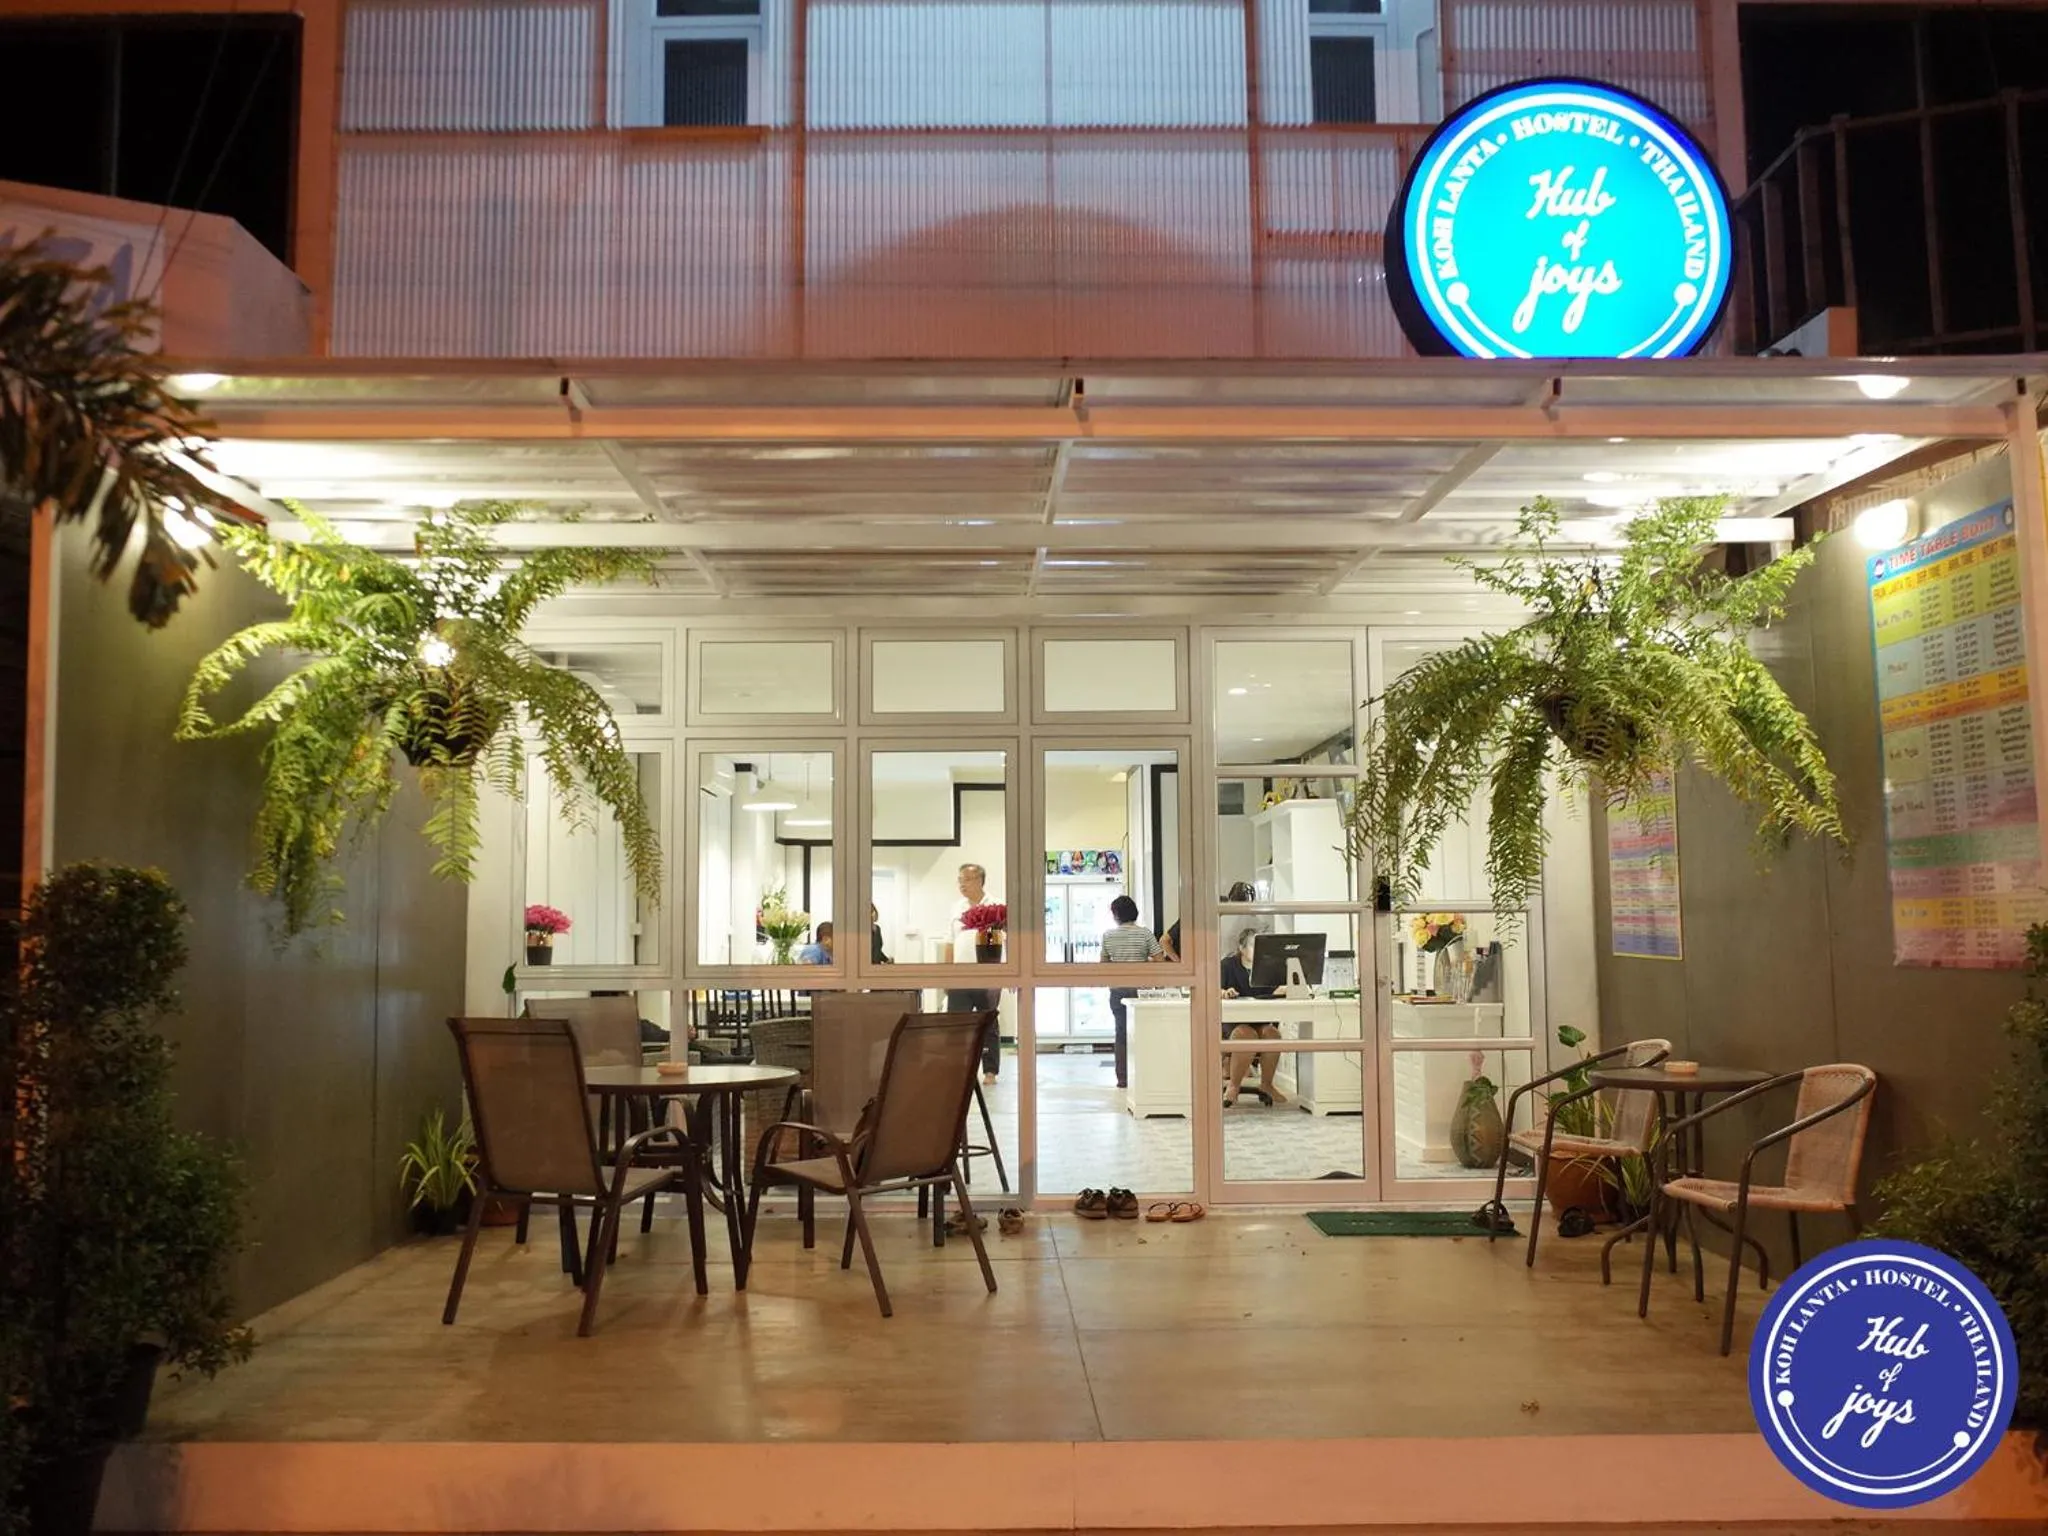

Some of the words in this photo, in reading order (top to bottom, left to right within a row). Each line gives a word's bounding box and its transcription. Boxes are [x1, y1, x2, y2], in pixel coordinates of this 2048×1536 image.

[1510, 112, 1625, 145] HOSTEL
[1437, 137, 1500, 215] LANTA
[1525, 165, 1617, 220] Hub
[1561, 219, 1590, 261] of
[1640, 141, 1706, 279] THAILAND
[1432, 216, 1459, 280] KOH
[1511, 255, 1622, 334] joys
